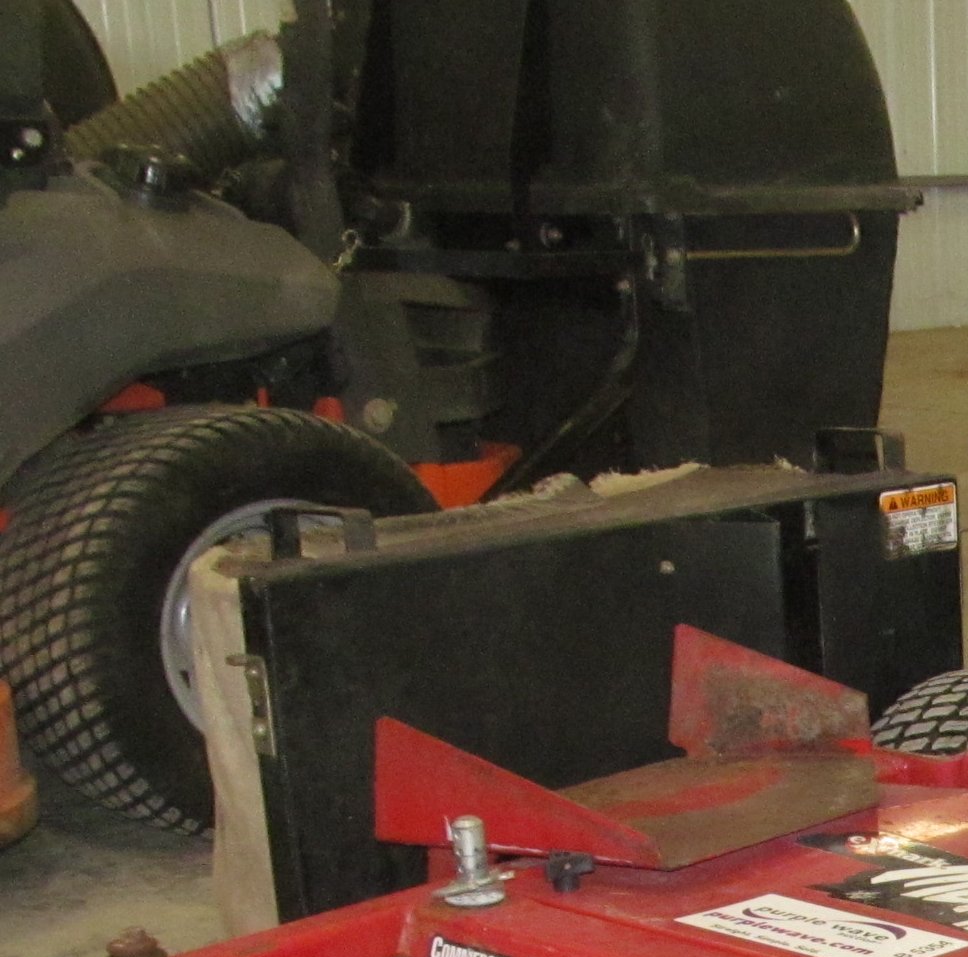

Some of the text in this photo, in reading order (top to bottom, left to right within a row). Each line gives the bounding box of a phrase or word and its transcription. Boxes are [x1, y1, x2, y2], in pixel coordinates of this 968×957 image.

[901, 489, 949, 509] WARNING
[703, 911, 875, 955] purplewave.com
[754, 906, 889, 941] purple wave
